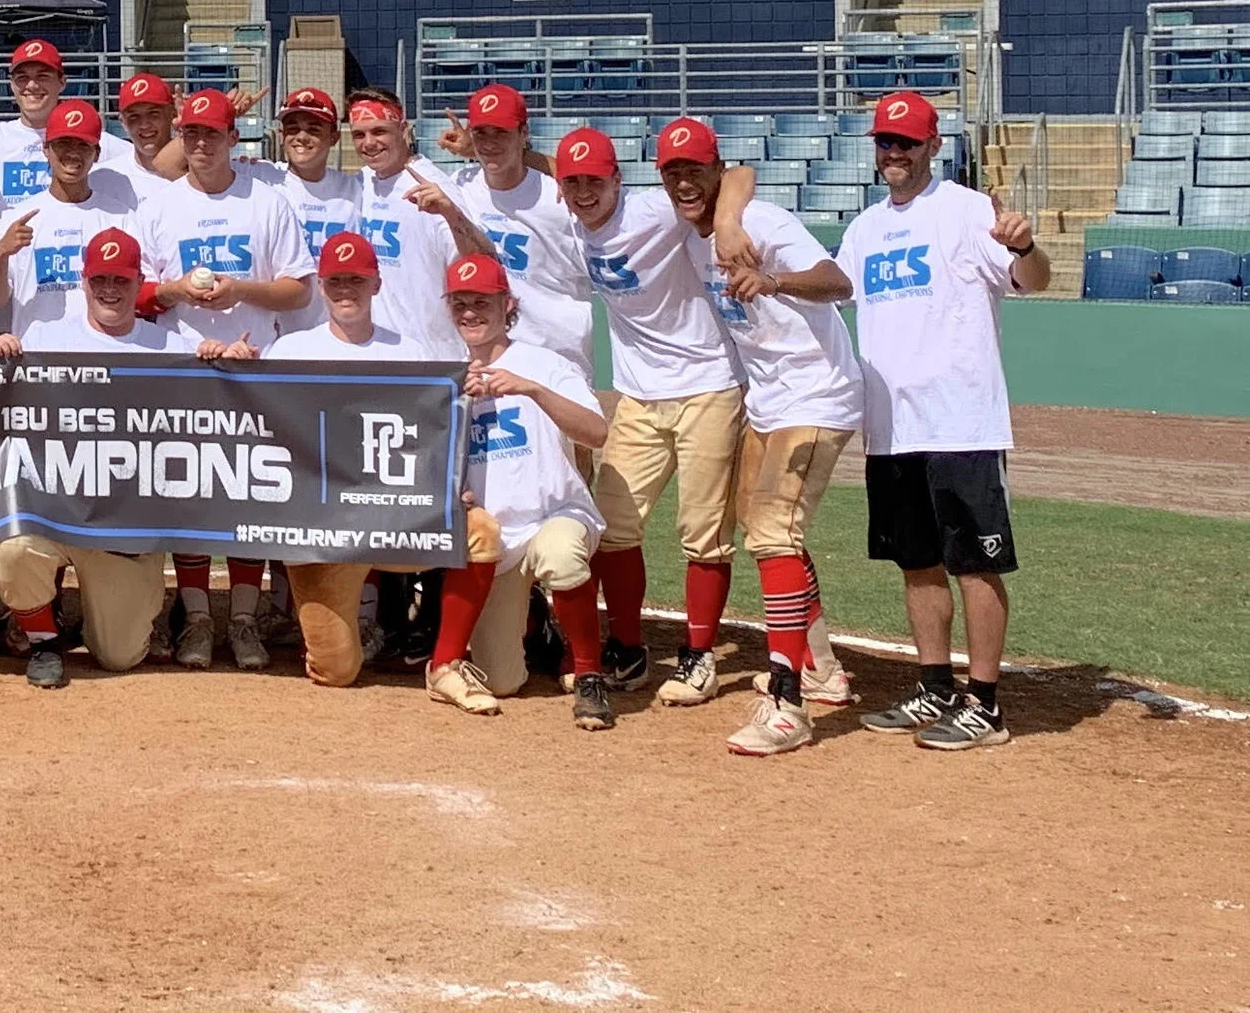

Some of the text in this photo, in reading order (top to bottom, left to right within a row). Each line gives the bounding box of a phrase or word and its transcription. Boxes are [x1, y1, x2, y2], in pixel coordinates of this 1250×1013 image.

[25, 42, 43, 58] D
[130, 78, 149, 97] D
[190, 96, 210, 115] D
[478, 94, 499, 113] D
[886, 100, 909, 120] D
[64, 110, 84, 128] D
[669, 127, 691, 148] D
[569, 141, 590, 162] D
[100, 241, 120, 261] D
[178, 234, 252, 275] BCS
[334, 242, 355, 262] D
[457, 261, 478, 282] D
[588, 254, 639, 290] CS
[864, 244, 931, 295] BCS
[11, 365, 112, 385] ACHIEVED.
[0, 405, 49, 432] 18U
[58, 407, 116, 433] BCS
[126, 407, 275, 438] NATIONAL
[468, 406, 528, 455] CS
[359, 412, 419, 486] PG
[339, 491, 435, 506] PERFECT GAME
[236, 523, 454, 552] #PGTOURNEY CHAMPS
